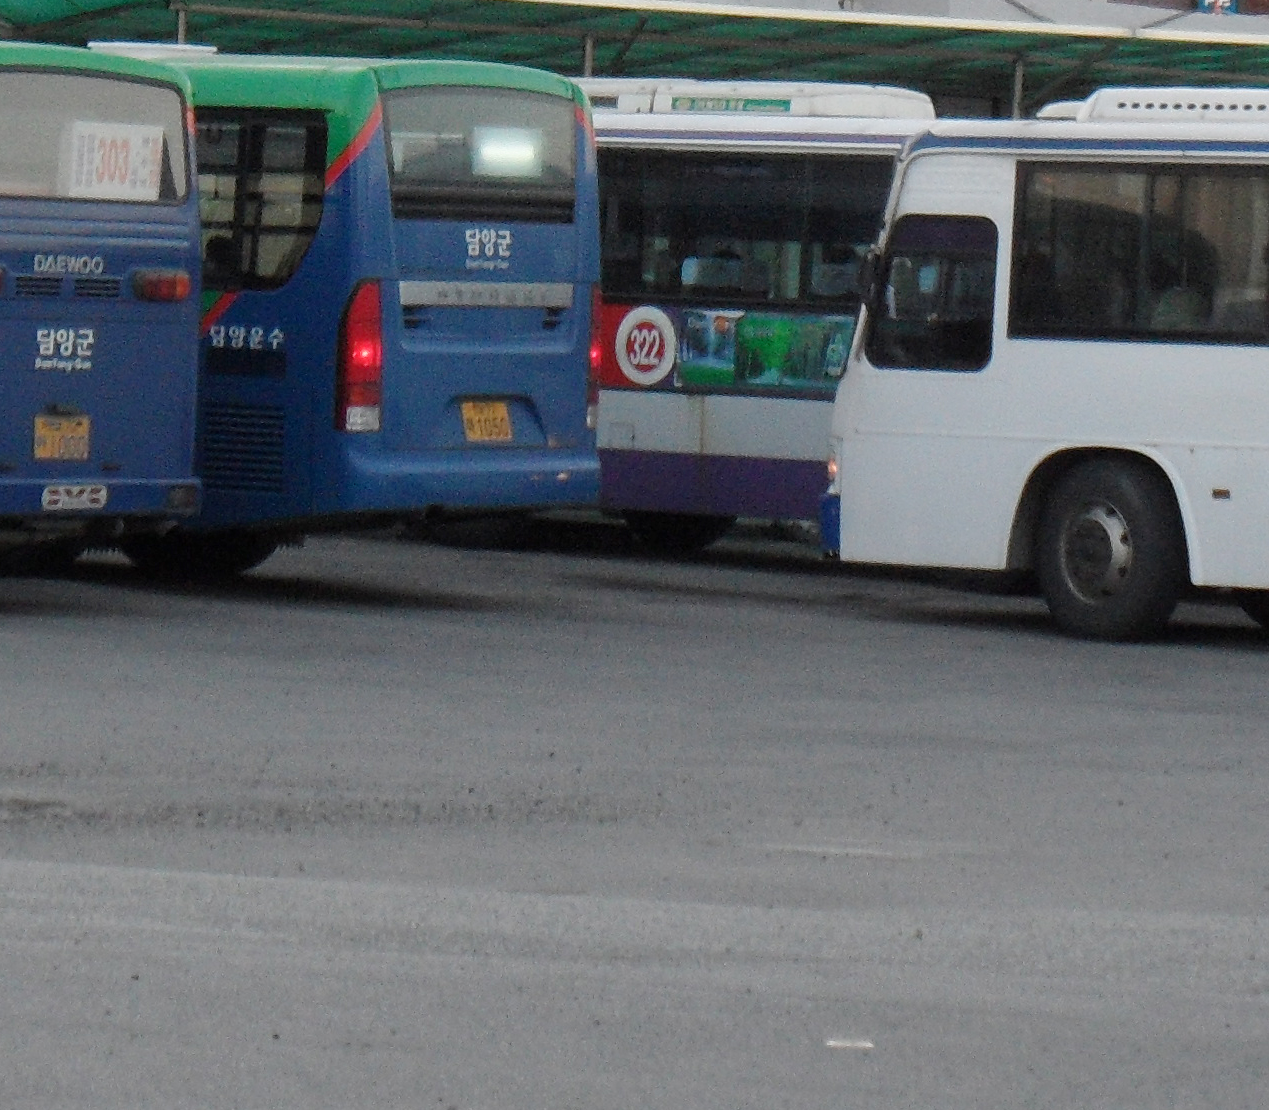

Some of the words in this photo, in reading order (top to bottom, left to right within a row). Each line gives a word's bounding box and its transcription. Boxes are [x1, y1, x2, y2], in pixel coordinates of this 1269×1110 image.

[465, 228, 513, 258] 담양군
[33, 254, 104, 274] DAEWOO
[35, 328, 95, 358] 담양군
[209, 324, 286, 350] 담양운수
[629, 328, 661, 366] 322
